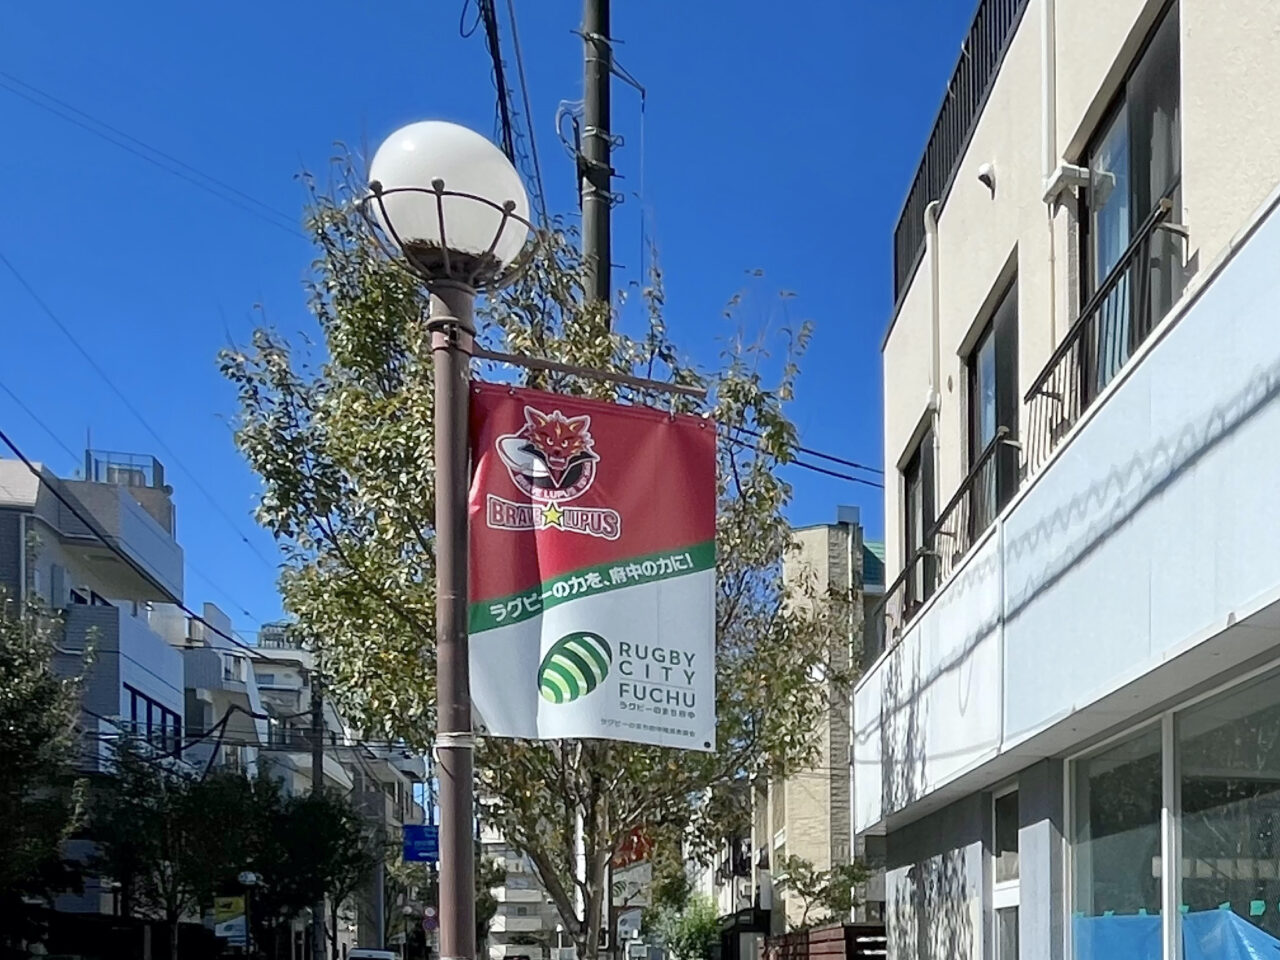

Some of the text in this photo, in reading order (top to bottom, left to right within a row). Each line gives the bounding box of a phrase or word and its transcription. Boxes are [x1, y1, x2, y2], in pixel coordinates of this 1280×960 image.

[489, 497, 619, 537] BRAVE LUPUS
[619, 641, 696, 668] RUGBY
[619, 660, 696, 685] CITY
[619, 683, 696, 708] FUCHU
